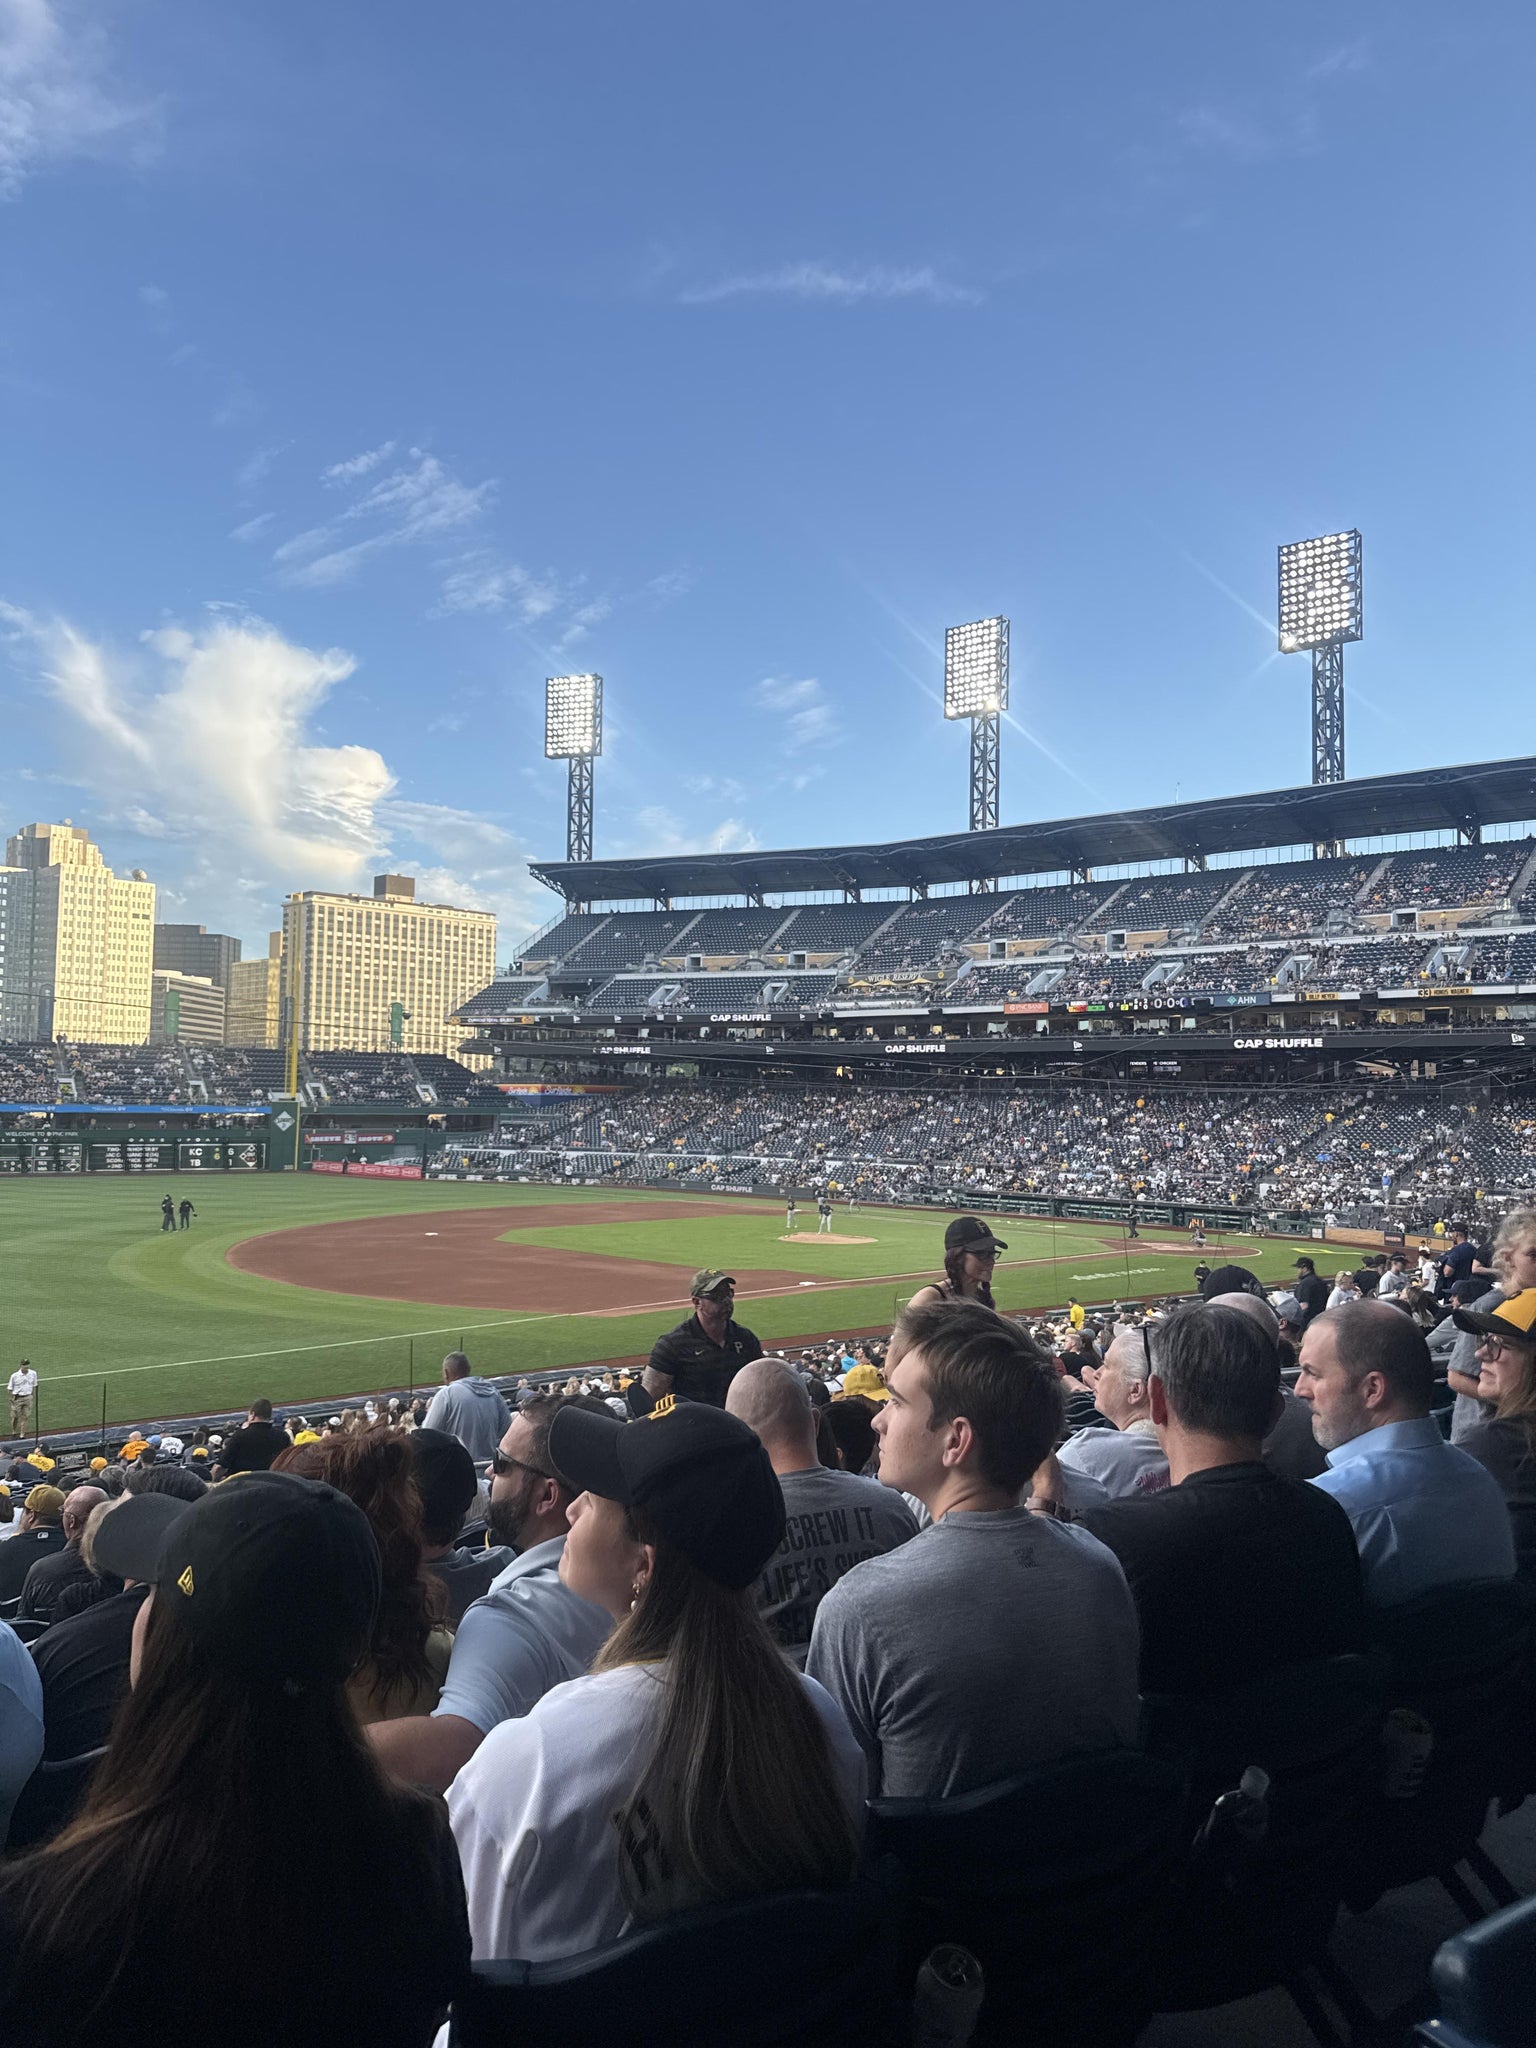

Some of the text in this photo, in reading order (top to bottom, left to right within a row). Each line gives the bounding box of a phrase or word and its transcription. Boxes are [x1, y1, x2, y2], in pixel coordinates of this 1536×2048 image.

[1237, 996, 1257, 1005] AHN
[710, 1014, 772, 1022] CAP SHUFFLE
[1233, 1037, 1323, 1049] CAP SHUFFLE
[884, 1044, 946, 1053] CAP SHUFFLE
[188, 1148, 234, 1156] KC 6
[190, 1159, 201, 1167] TB
[725, 1185, 753, 1193] SHUFFLE
[734, 1341, 743, 1354] P
[853, 1506, 876, 1541] IT
[761, 1556, 831, 1606] LIFE'S
